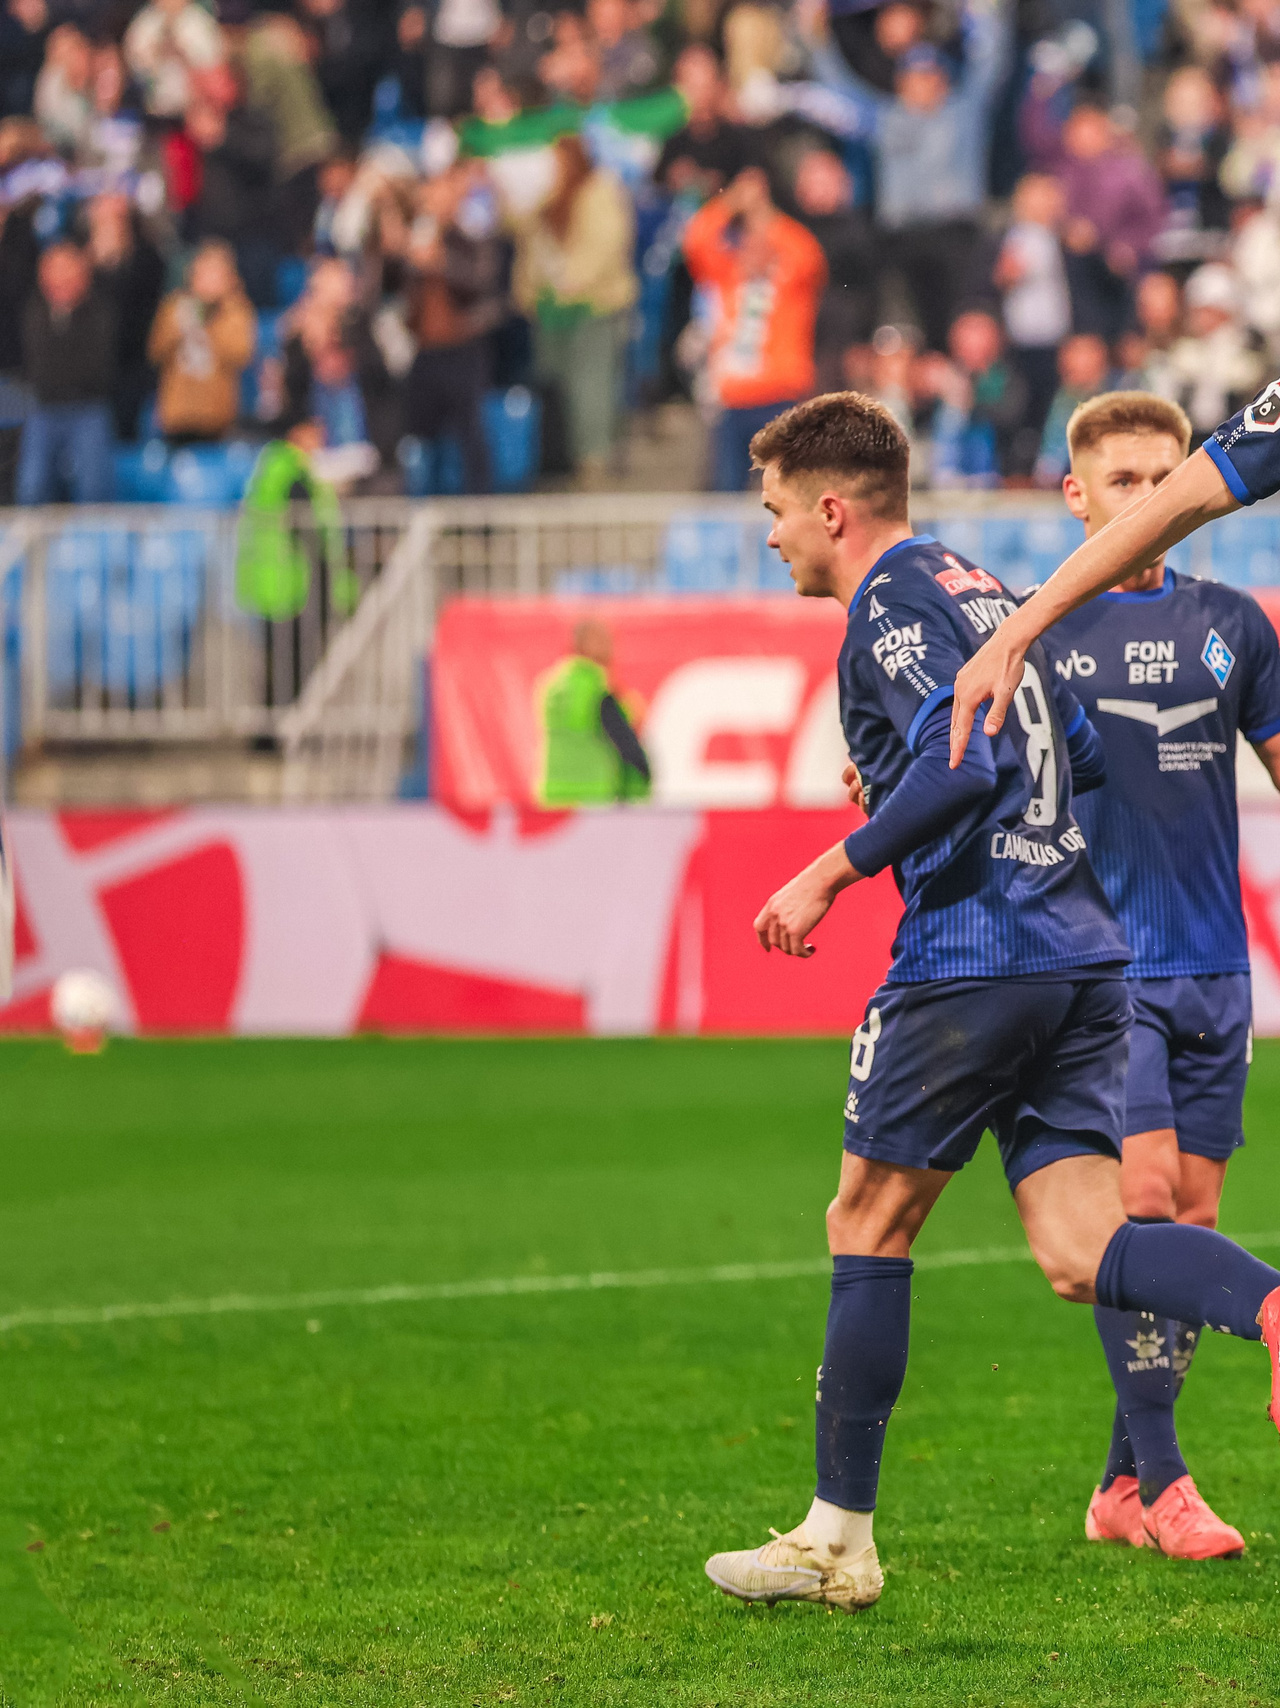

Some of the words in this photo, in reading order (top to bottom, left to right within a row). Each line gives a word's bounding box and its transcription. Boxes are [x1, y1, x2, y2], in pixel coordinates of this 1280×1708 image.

[872, 621, 922, 664] FON
[1124, 640, 1175, 663] FON
[882, 643, 928, 681] BET
[1128, 661, 1179, 685] BET
[850, 1006, 882, 1082] 8
